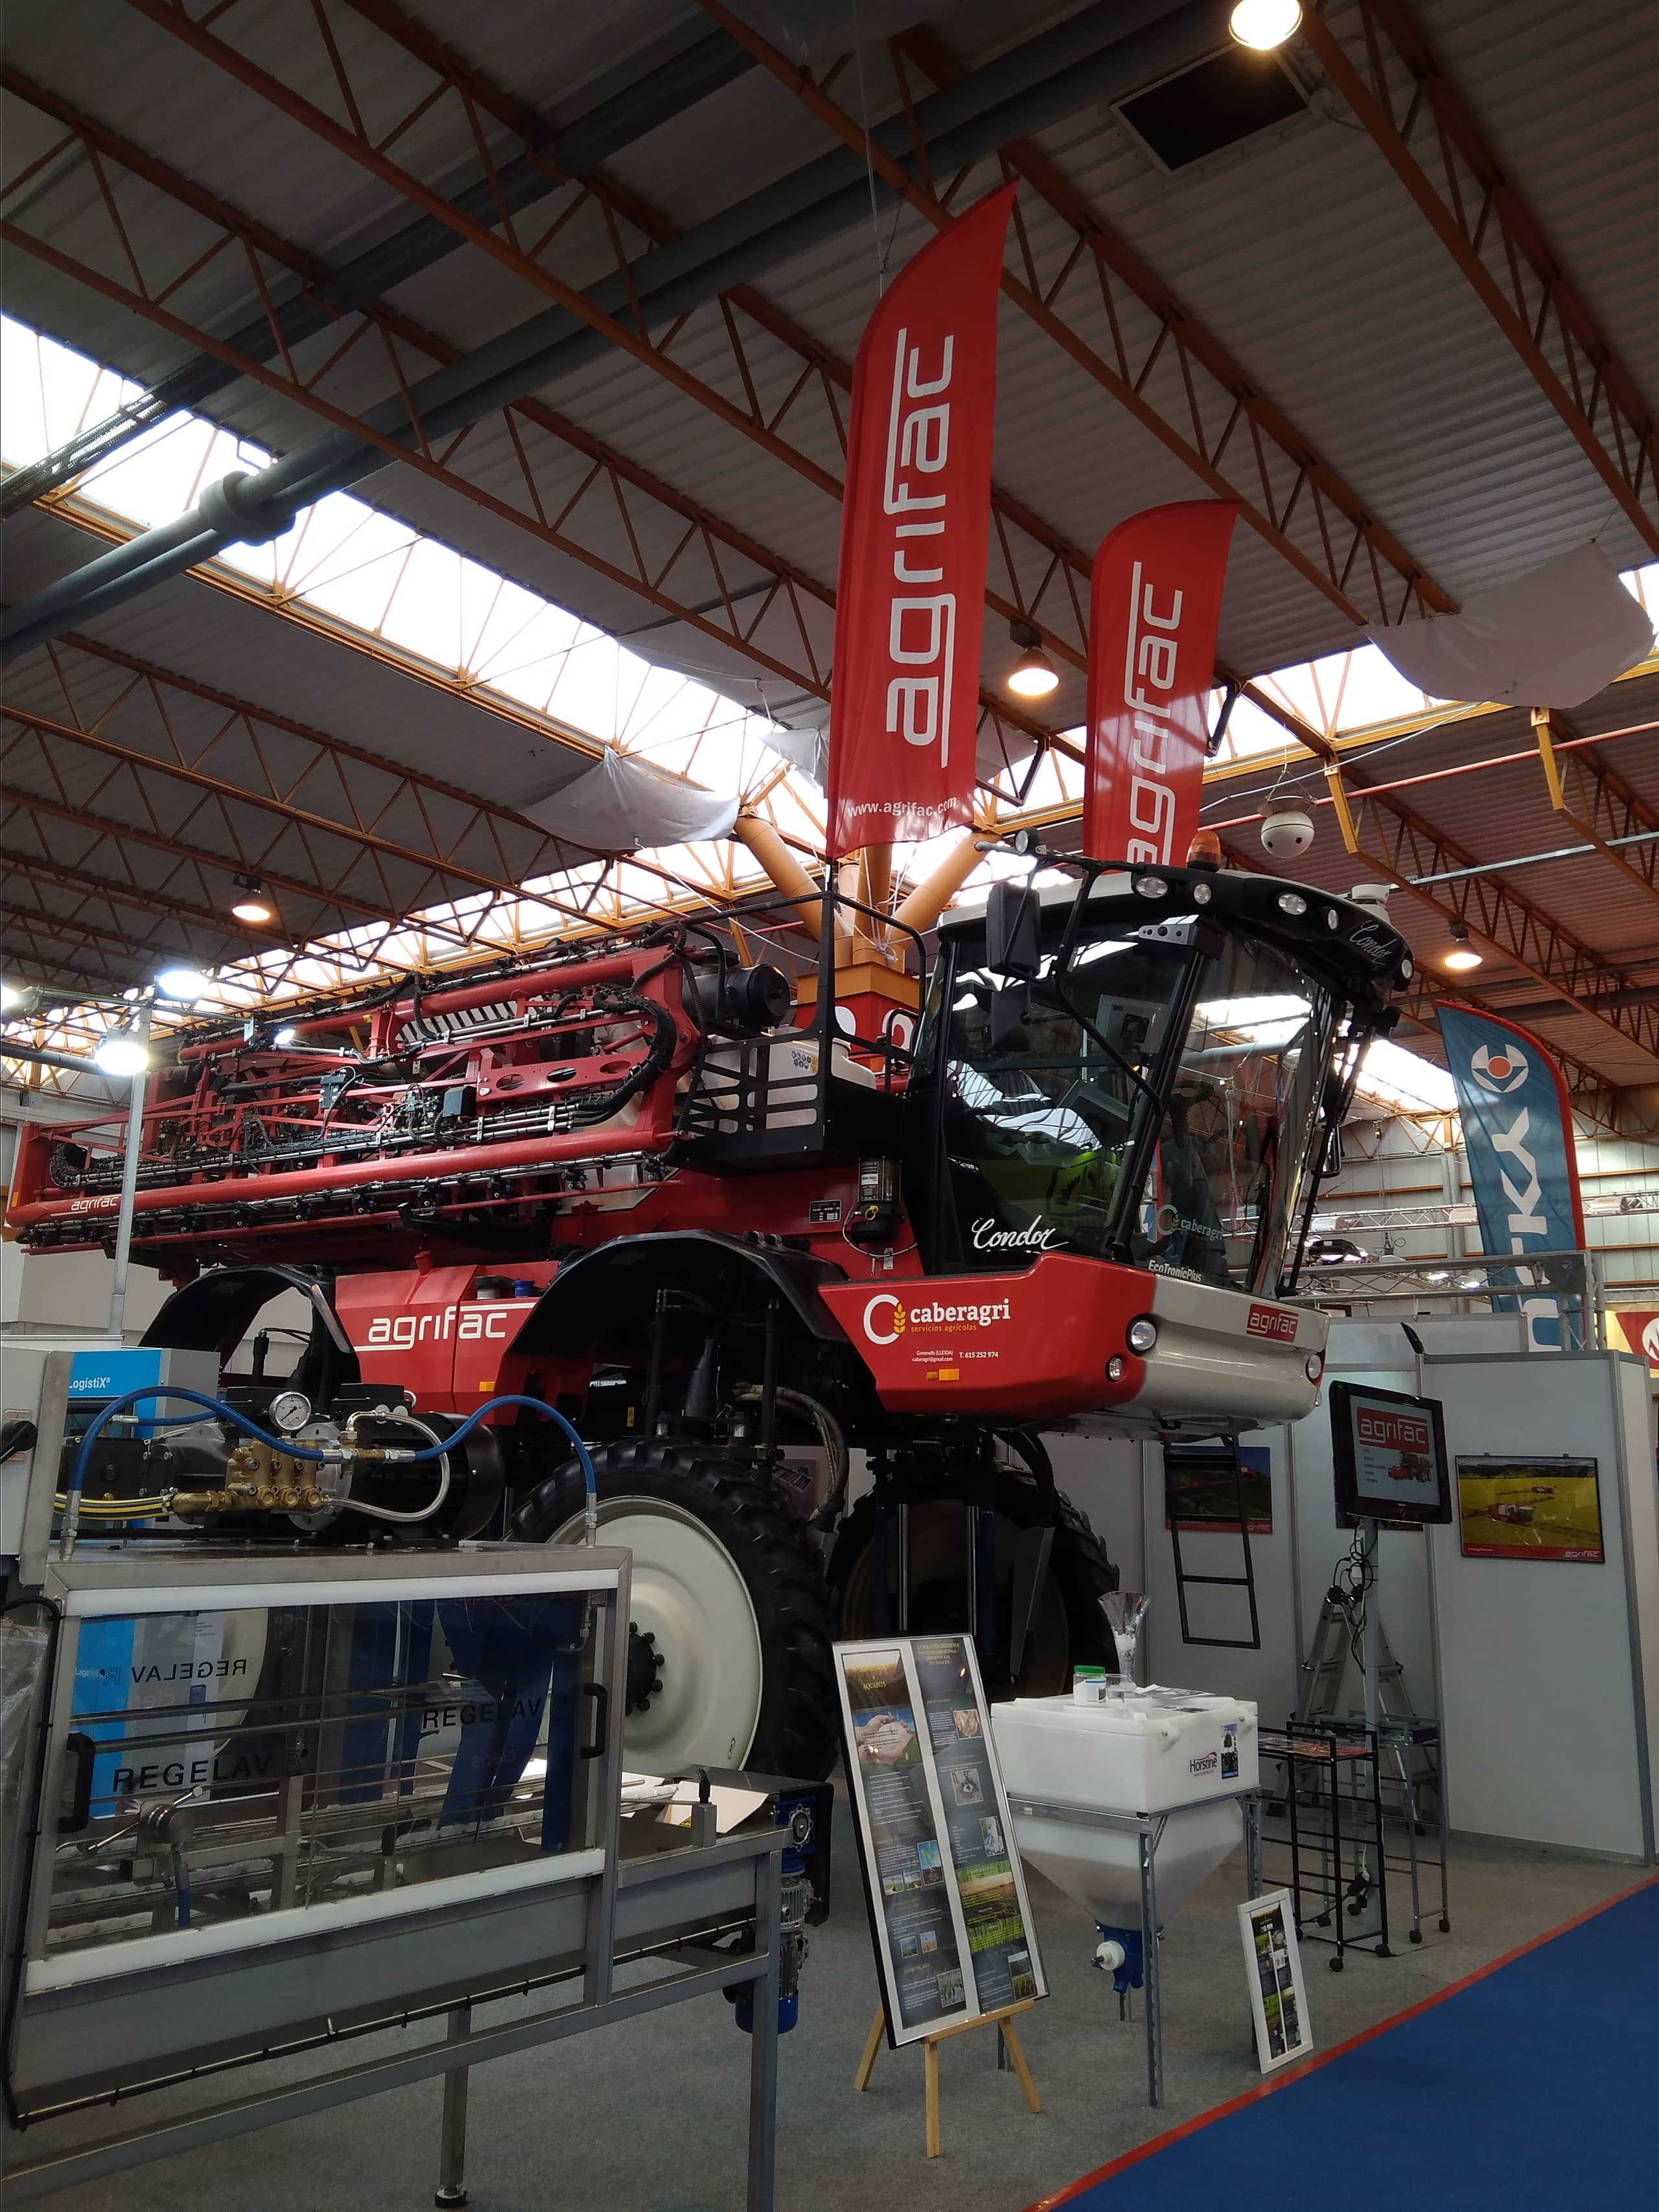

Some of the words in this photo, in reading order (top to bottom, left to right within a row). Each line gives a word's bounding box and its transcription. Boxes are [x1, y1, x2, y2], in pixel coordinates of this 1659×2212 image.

[883, 327, 956, 769] agrifac
[848, 797, 957, 817] www.agrifac.com
[1349, 920, 1398, 965] Condor
[56, 1194, 124, 1215] agrifac
[971, 1215, 1069, 1250] Condor
[1181, 1219, 1224, 1240] caberagri
[1148, 1259, 1201, 1282] EcoTronicPlus
[911, 1298, 1010, 1326] caberagri
[1246, 1312, 1299, 1334] agrifac
[354, 1302, 536, 1351] agrifac
[1359, 1418, 1426, 1444] agrifac
[423, 1697, 541, 1729] REGELAV
[112, 1752, 271, 1792] REGELAV
[1190, 1756, 1218, 1773] Horstine
